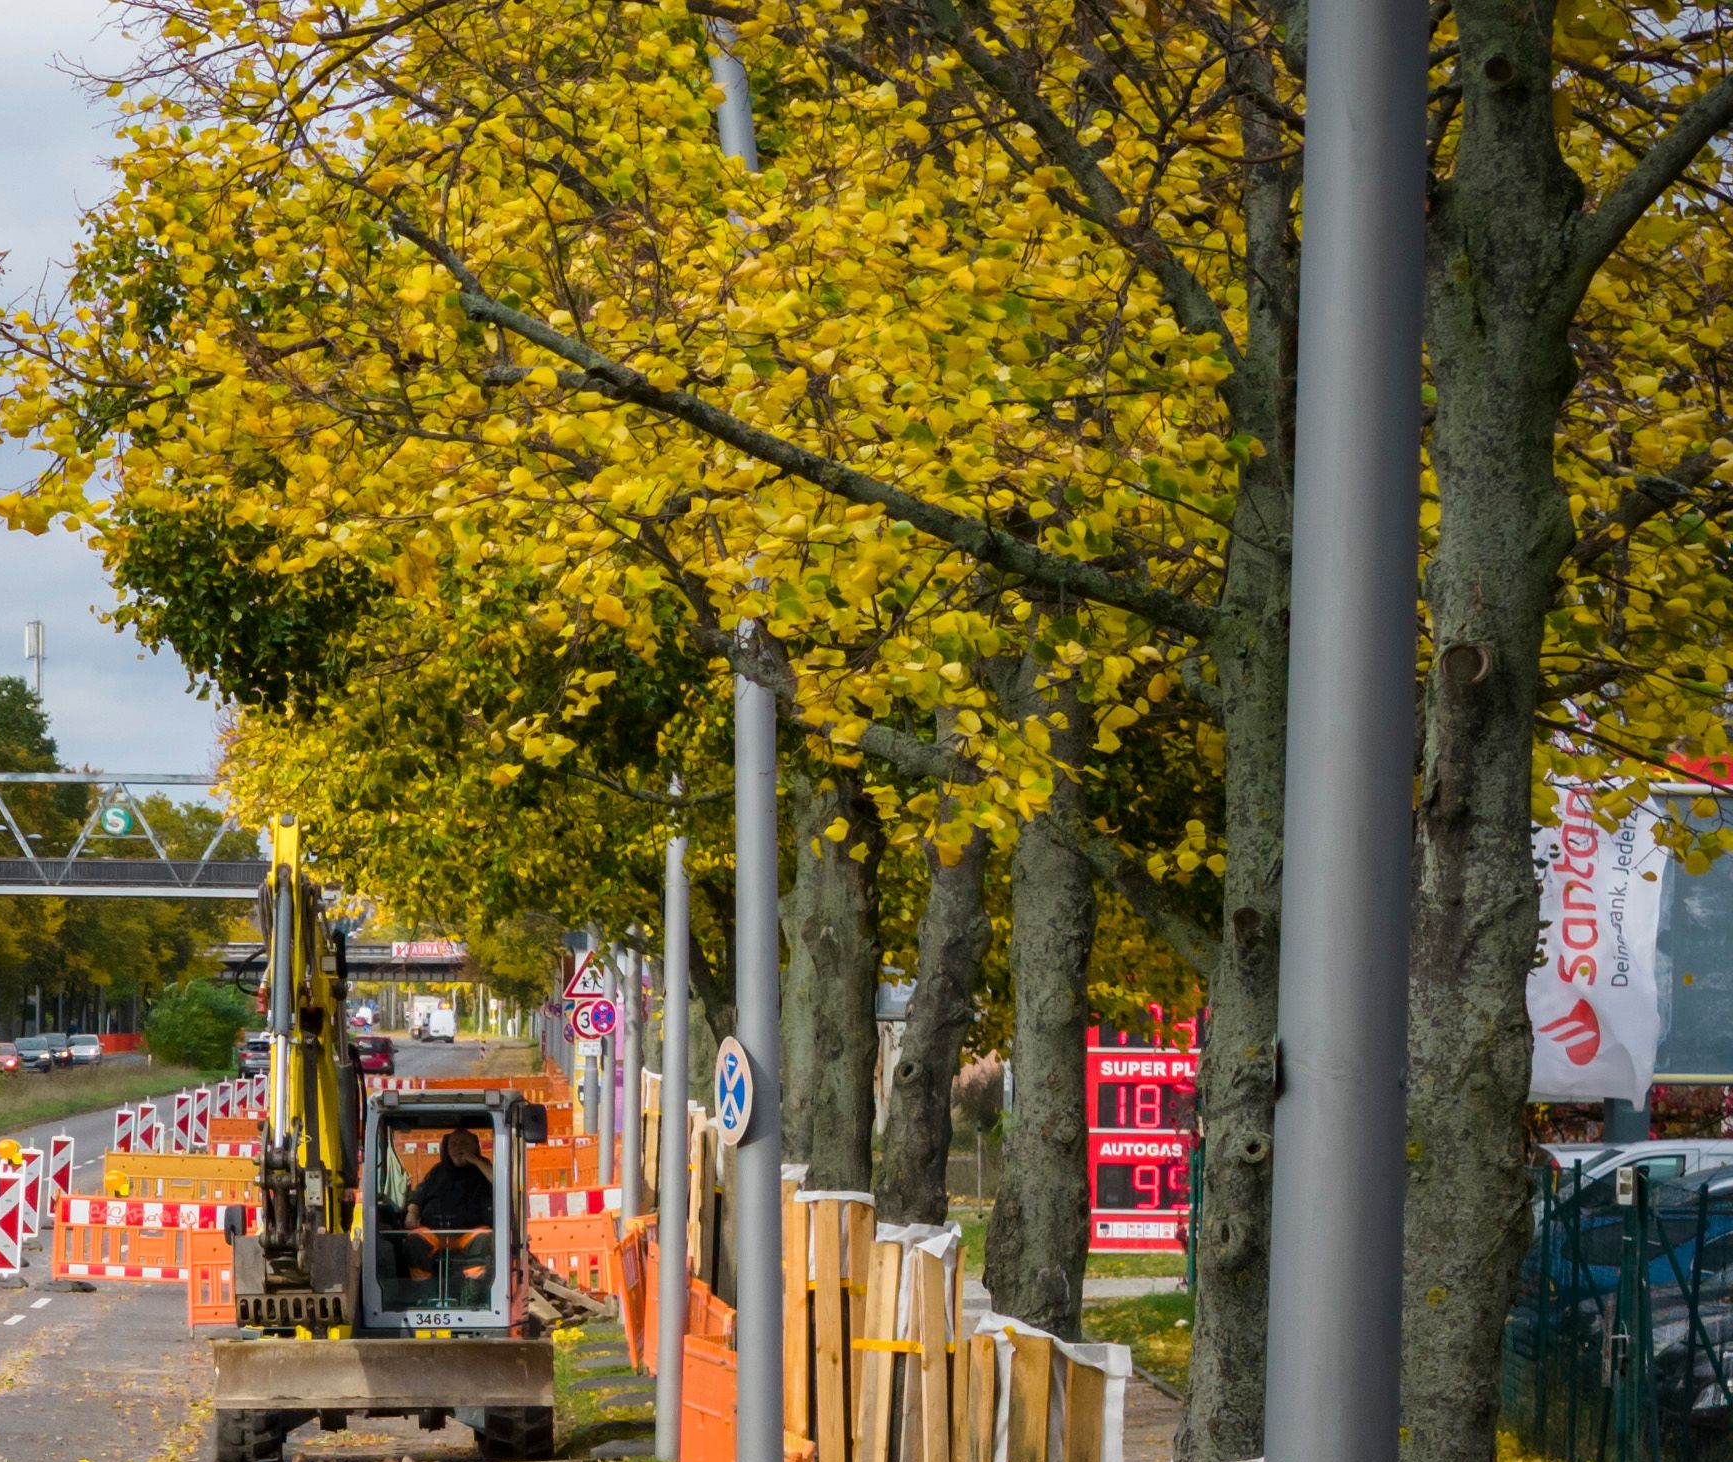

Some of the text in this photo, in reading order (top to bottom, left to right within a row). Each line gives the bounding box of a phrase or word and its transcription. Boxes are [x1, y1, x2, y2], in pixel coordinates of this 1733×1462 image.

[106, 807, 125, 833] S
[1553, 786, 1599, 987] Santan
[580, 1011, 590, 1029] 3
[1100, 1061, 1196, 1077] SUPER PL
[1100, 1143, 1183, 1157] AUTOGAS
[416, 1313, 451, 1326] 3465
